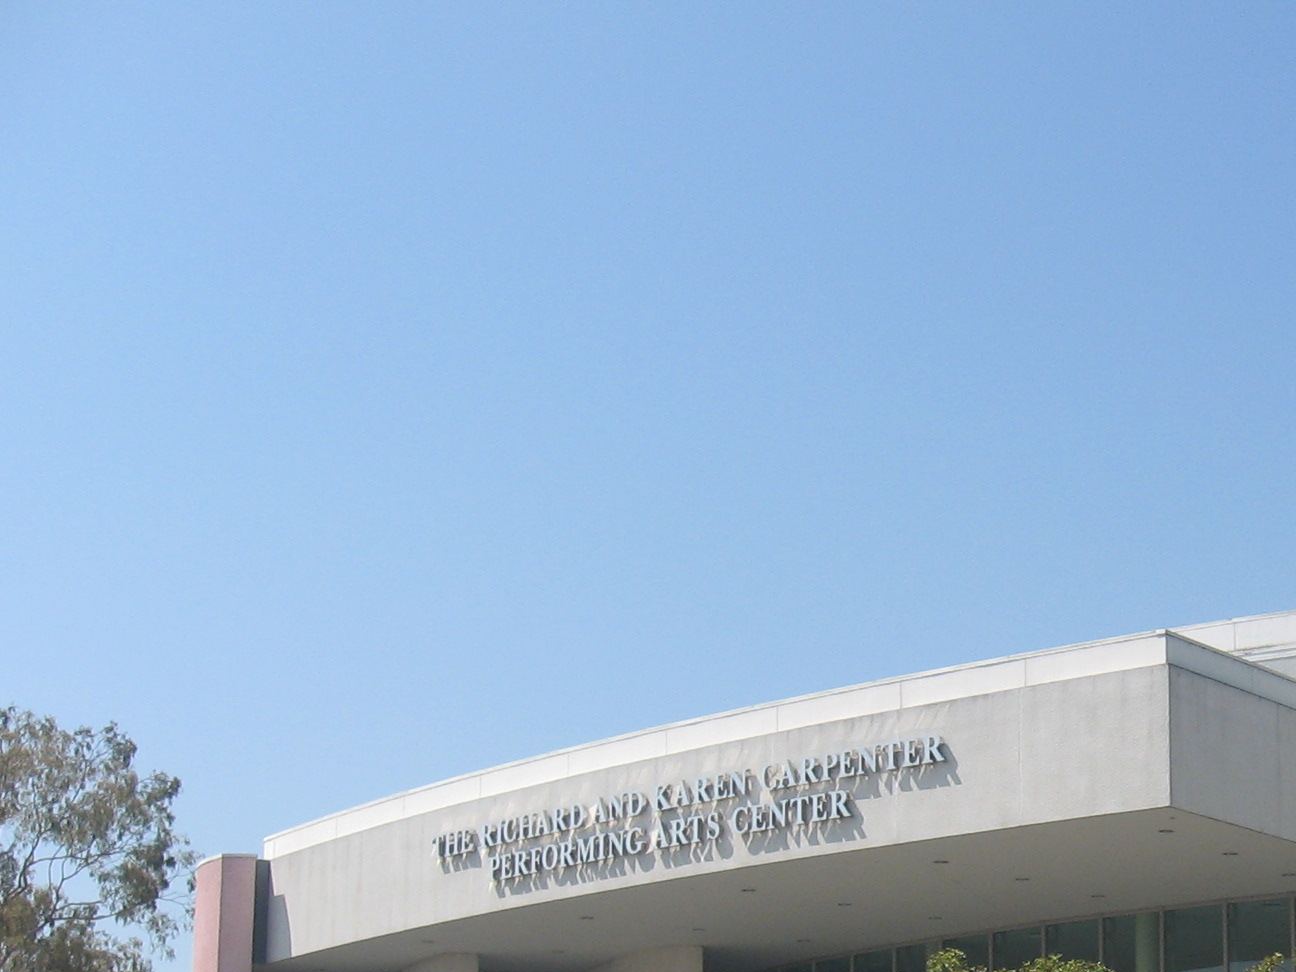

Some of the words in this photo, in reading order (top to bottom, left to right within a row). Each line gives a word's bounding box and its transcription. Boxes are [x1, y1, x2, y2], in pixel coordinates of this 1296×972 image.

[431, 829, 475, 860] THE
[479, 802, 585, 849] RICHARD
[592, 791, 646, 823] AND
[651, 769, 750, 812] KAREN
[761, 734, 946, 791] CARPENTER
[489, 826, 647, 880] PERFORMING
[651, 812, 721, 851] ARTS
[729, 789, 851, 834] CENTER
